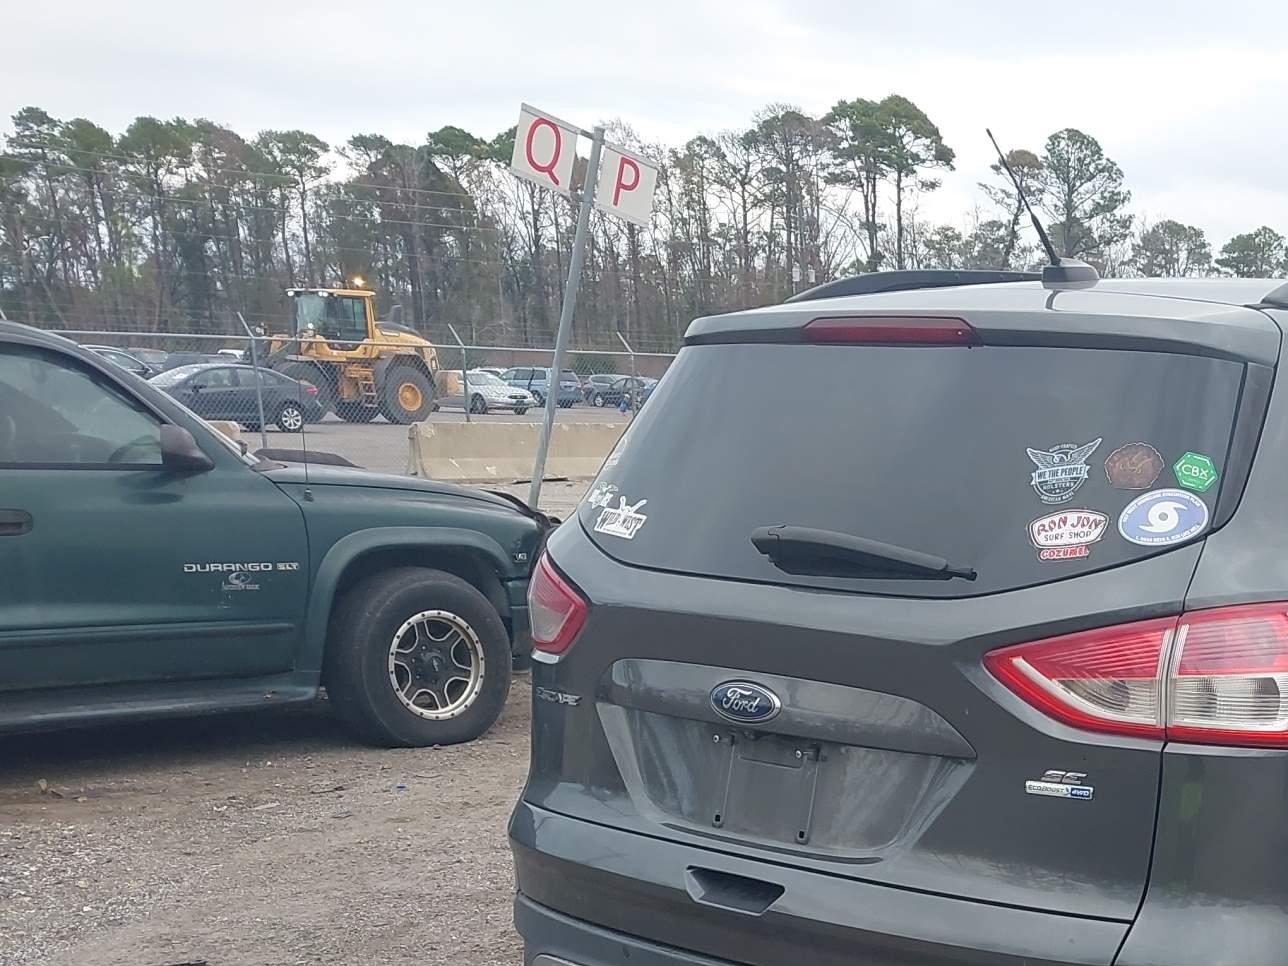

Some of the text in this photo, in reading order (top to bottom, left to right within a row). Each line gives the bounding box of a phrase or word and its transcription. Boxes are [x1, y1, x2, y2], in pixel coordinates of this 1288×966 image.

[526, 117, 562, 186] Q
[612, 156, 640, 207] P
[1037, 465, 1084, 480] WE THE PEOPLE
[1181, 464, 1209, 480] CBX
[1037, 516, 1068, 536] RON
[1070, 515, 1104, 530] JON
[1044, 530, 1092, 542] SURF SHOP
[1041, 545, 1090, 558] COZUMEL
[183, 562, 300, 572] DURANGO SLT
[722, 686, 761, 713] Ford
[1041, 769, 1089, 785] SE
[1028, 785, 1065, 794] ECOBOOST
